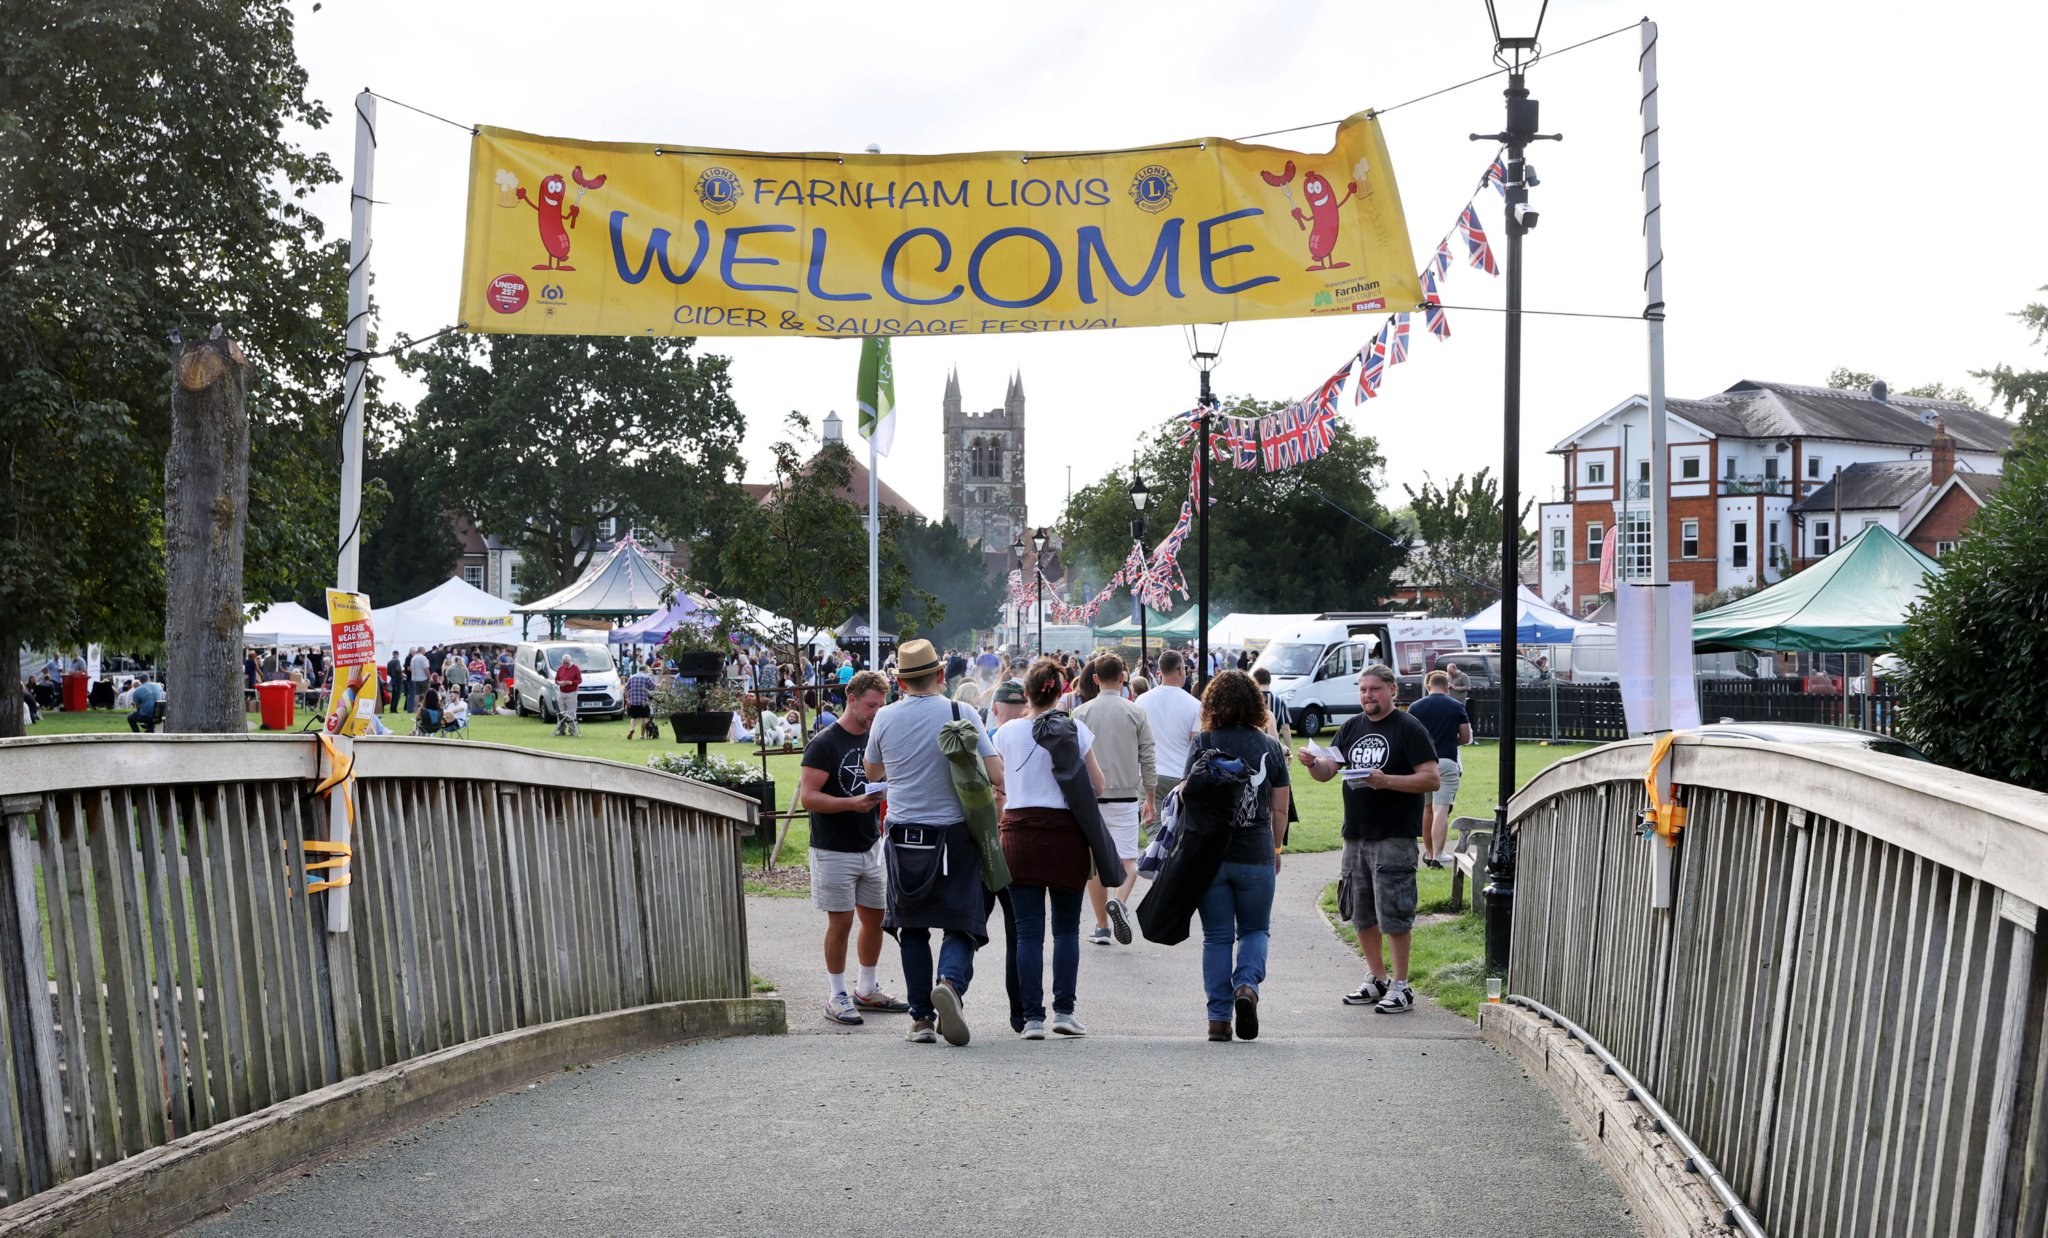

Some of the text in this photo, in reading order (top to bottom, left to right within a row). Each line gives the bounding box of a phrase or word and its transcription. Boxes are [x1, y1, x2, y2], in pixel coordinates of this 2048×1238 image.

[705, 169, 734, 180] LIONS
[1138, 168, 1166, 178] LIONS
[713, 182, 726, 198] L
[754, 178, 1111, 210] FARNHAM LIONS
[1148, 180, 1161, 198] L
[608, 207, 1281, 309] WELCOME
[494, 280, 524, 291] UNDER
[1335, 280, 1380, 297] Farnham
[1336, 288, 1382, 304] Town Council
[1356, 301, 1381, 311] Biffa
[674, 304, 1127, 334] CIDER & SAUSAGE FESTIVAL
[338, 631, 370, 642] WEAR YOUR
[343, 623, 365, 634] PLEASE
[336, 640, 372, 651] WRISTBANDS
[1352, 748, 1386, 764] GBW
